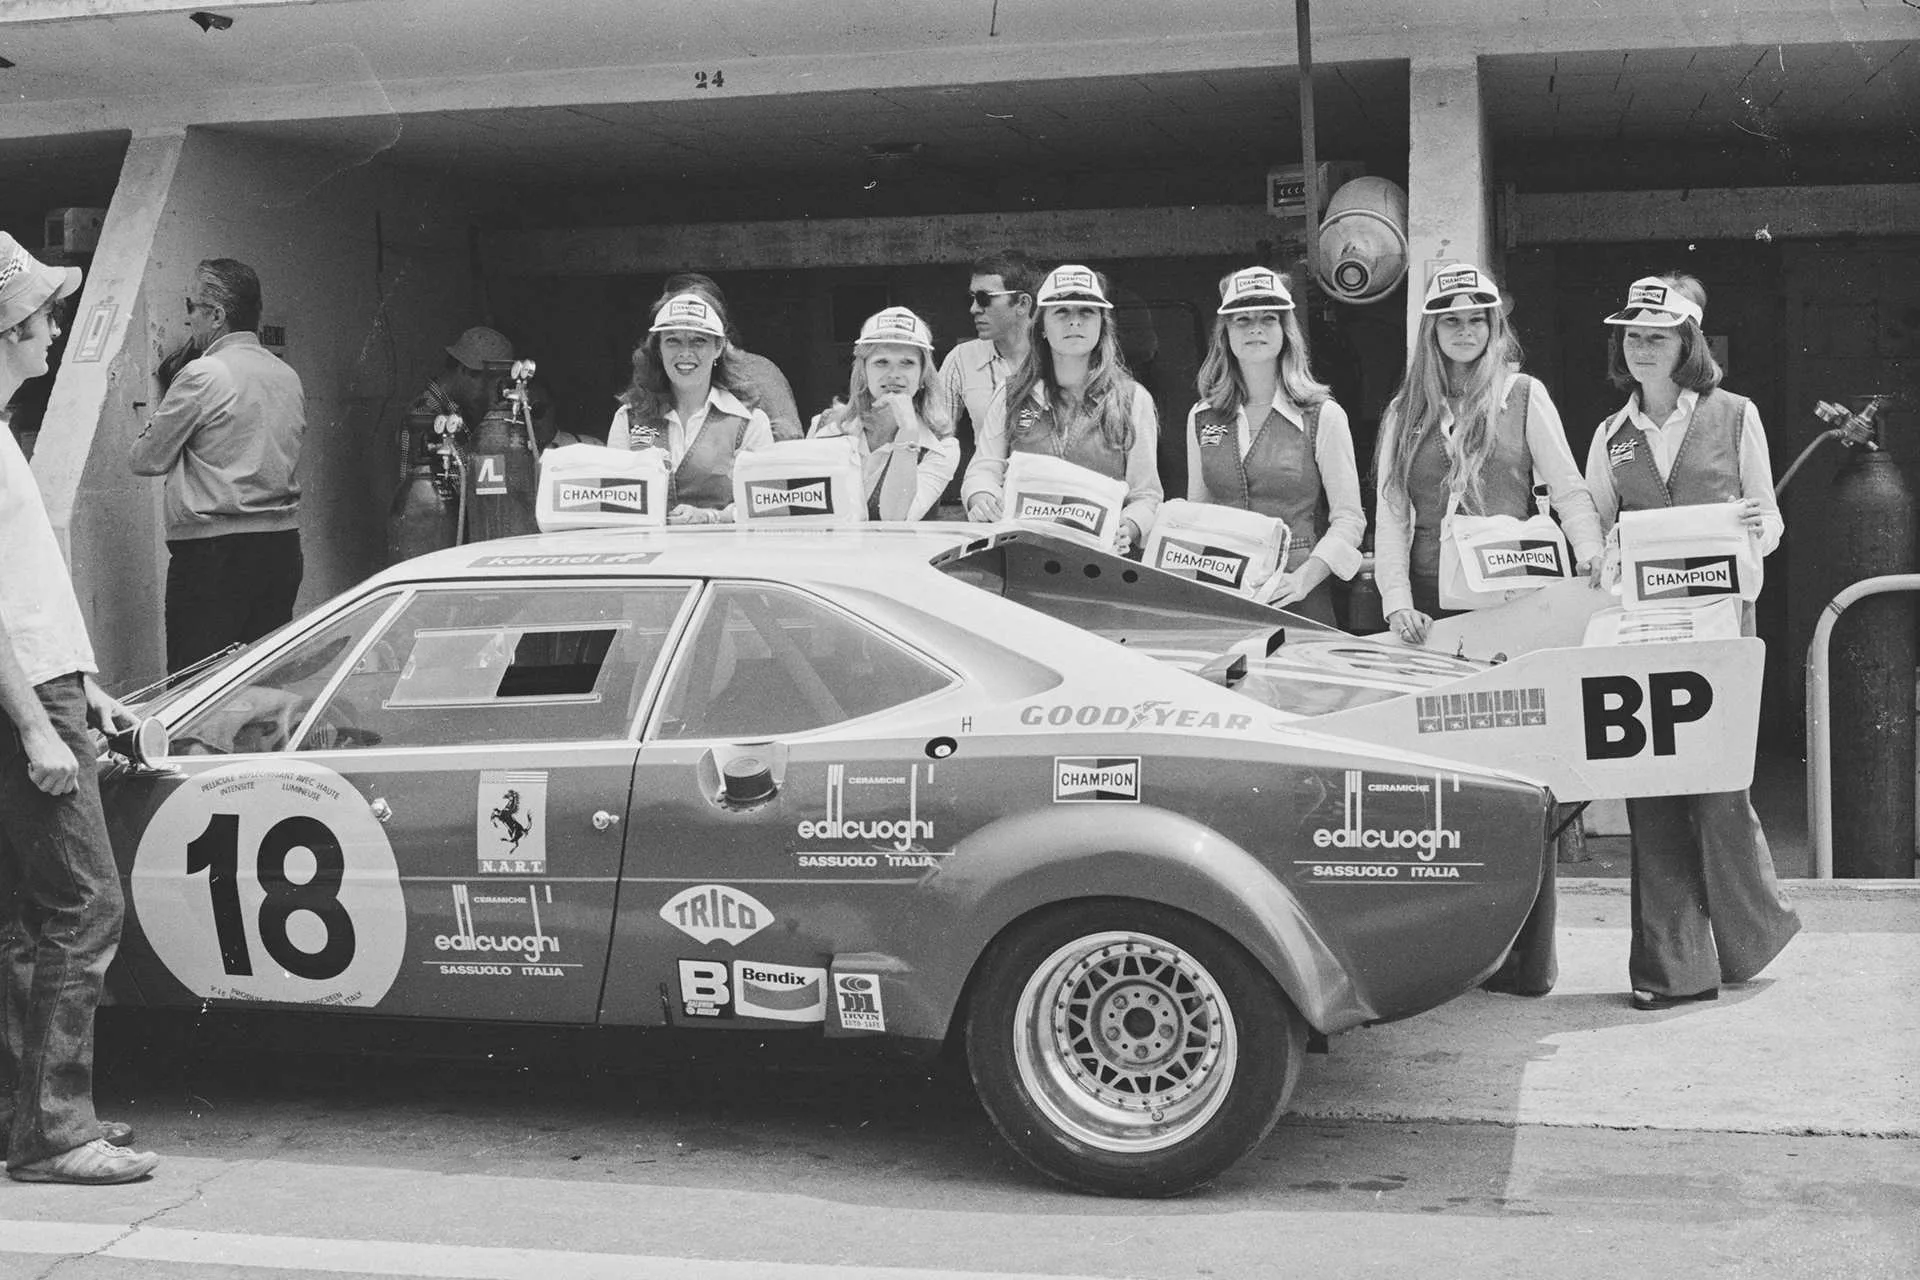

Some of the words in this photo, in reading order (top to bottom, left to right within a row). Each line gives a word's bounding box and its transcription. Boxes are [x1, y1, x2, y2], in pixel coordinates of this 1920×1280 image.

[695, 70, 724, 89] 24
[562, 489, 638, 502] CHAMPION
[755, 490, 823, 505] CHAMPION
[1024, 504, 1096, 523] CHAMPION
[1165, 550, 1236, 576] CHAMPION
[1487, 551, 1554, 566] CHAMPION
[1646, 569, 1728, 587] CHAMPION
[961, 716, 972, 732] H
[1020, 702, 1252, 731] GOODYEAR
[1581, 670, 1714, 761] BP
[296, 774, 315, 787] AVEC
[316, 782, 341, 801] HAUTE
[848, 777, 906, 785] CERAMICHE
[1061, 772, 1134, 787] CHAMPION
[1367, 783, 1430, 793] CERAMICHE
[797, 764, 935, 851] edilcuoghi
[1312, 770, 1461, 862] edilcuoghi
[798, 856, 877, 867] SASSUOLO
[887, 856, 933, 867] ITALIA
[1312, 865, 1399, 878] SASSUOLO
[1410, 866, 1460, 878] ITALIA
[186, 813, 356, 981] 18
[473, 896, 527, 904] CERAMICHE
[674, 888, 757, 930] TRICO
[434, 884, 560, 962] edilcuoghi
[440, 965, 512, 976] SASSUOLO
[521, 966, 564, 977] ITALIA
[742, 967, 806, 986] Bendix
